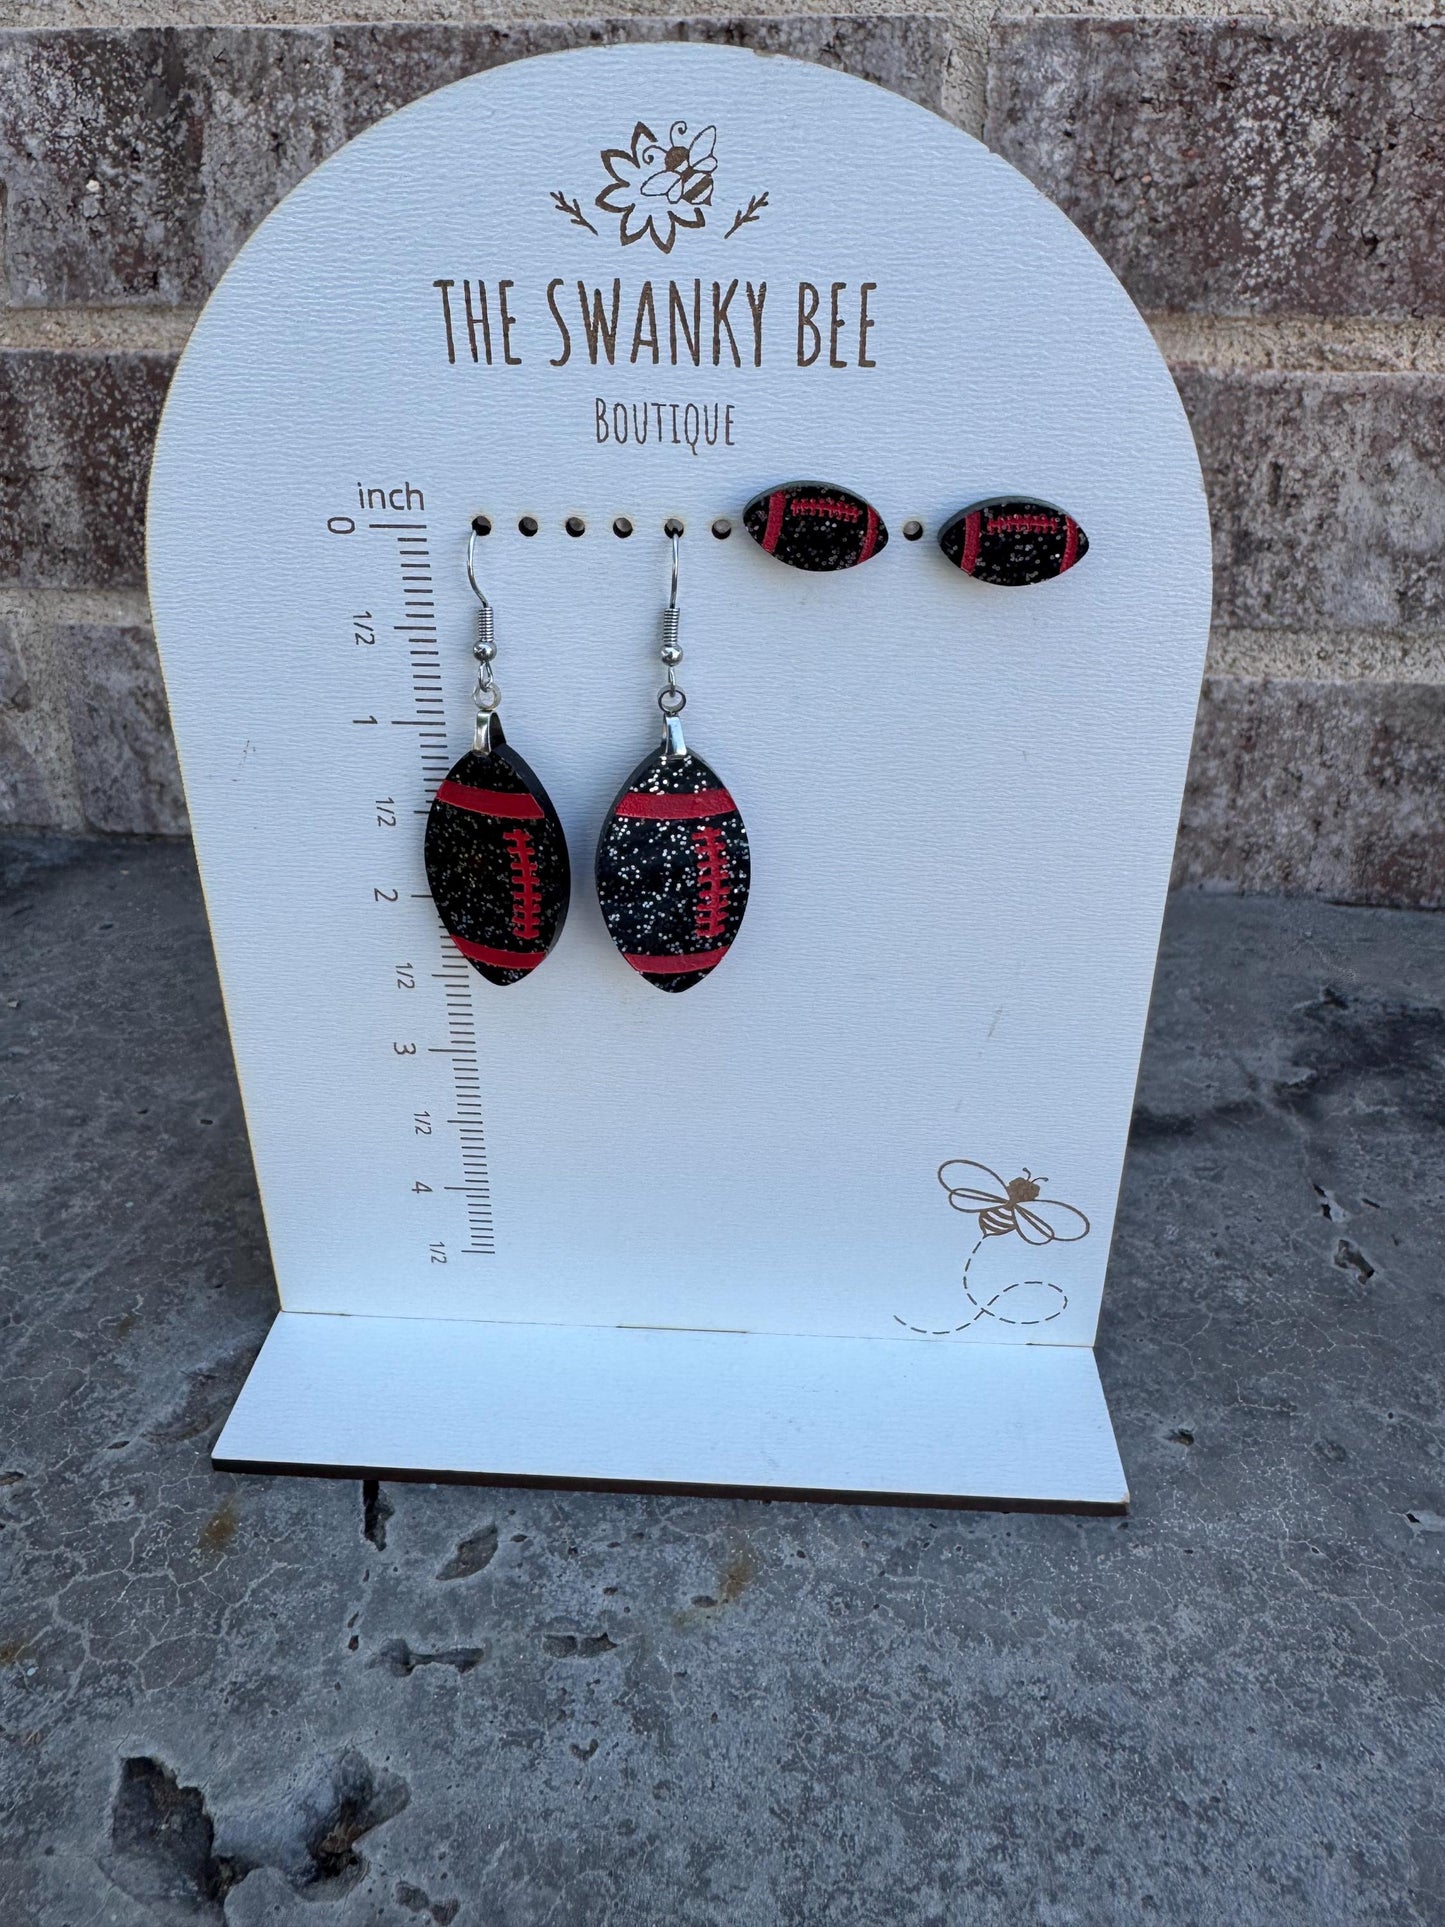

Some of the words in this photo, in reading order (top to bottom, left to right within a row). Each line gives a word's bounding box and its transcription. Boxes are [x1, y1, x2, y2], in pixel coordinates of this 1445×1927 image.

[432, 279, 522, 366] THE
[546, 277, 768, 368] SWANKY
[796, 281, 878, 369] BEE
[595, 397, 736, 456] BOUTIQUE
[357, 481, 426, 511] inch
[326, 516, 356, 535] 0
[352, 610, 376, 646] 1/2
[375, 796, 397, 828] 1/2
[373, 887, 399, 902] 2
[394, 961, 416, 990] 1/2
[393, 1041, 417, 1056] 3
[413, 1110, 432, 1136] 1/2
[410, 1180, 433, 1195] 4
[429, 1240, 447, 1265] 1/2
